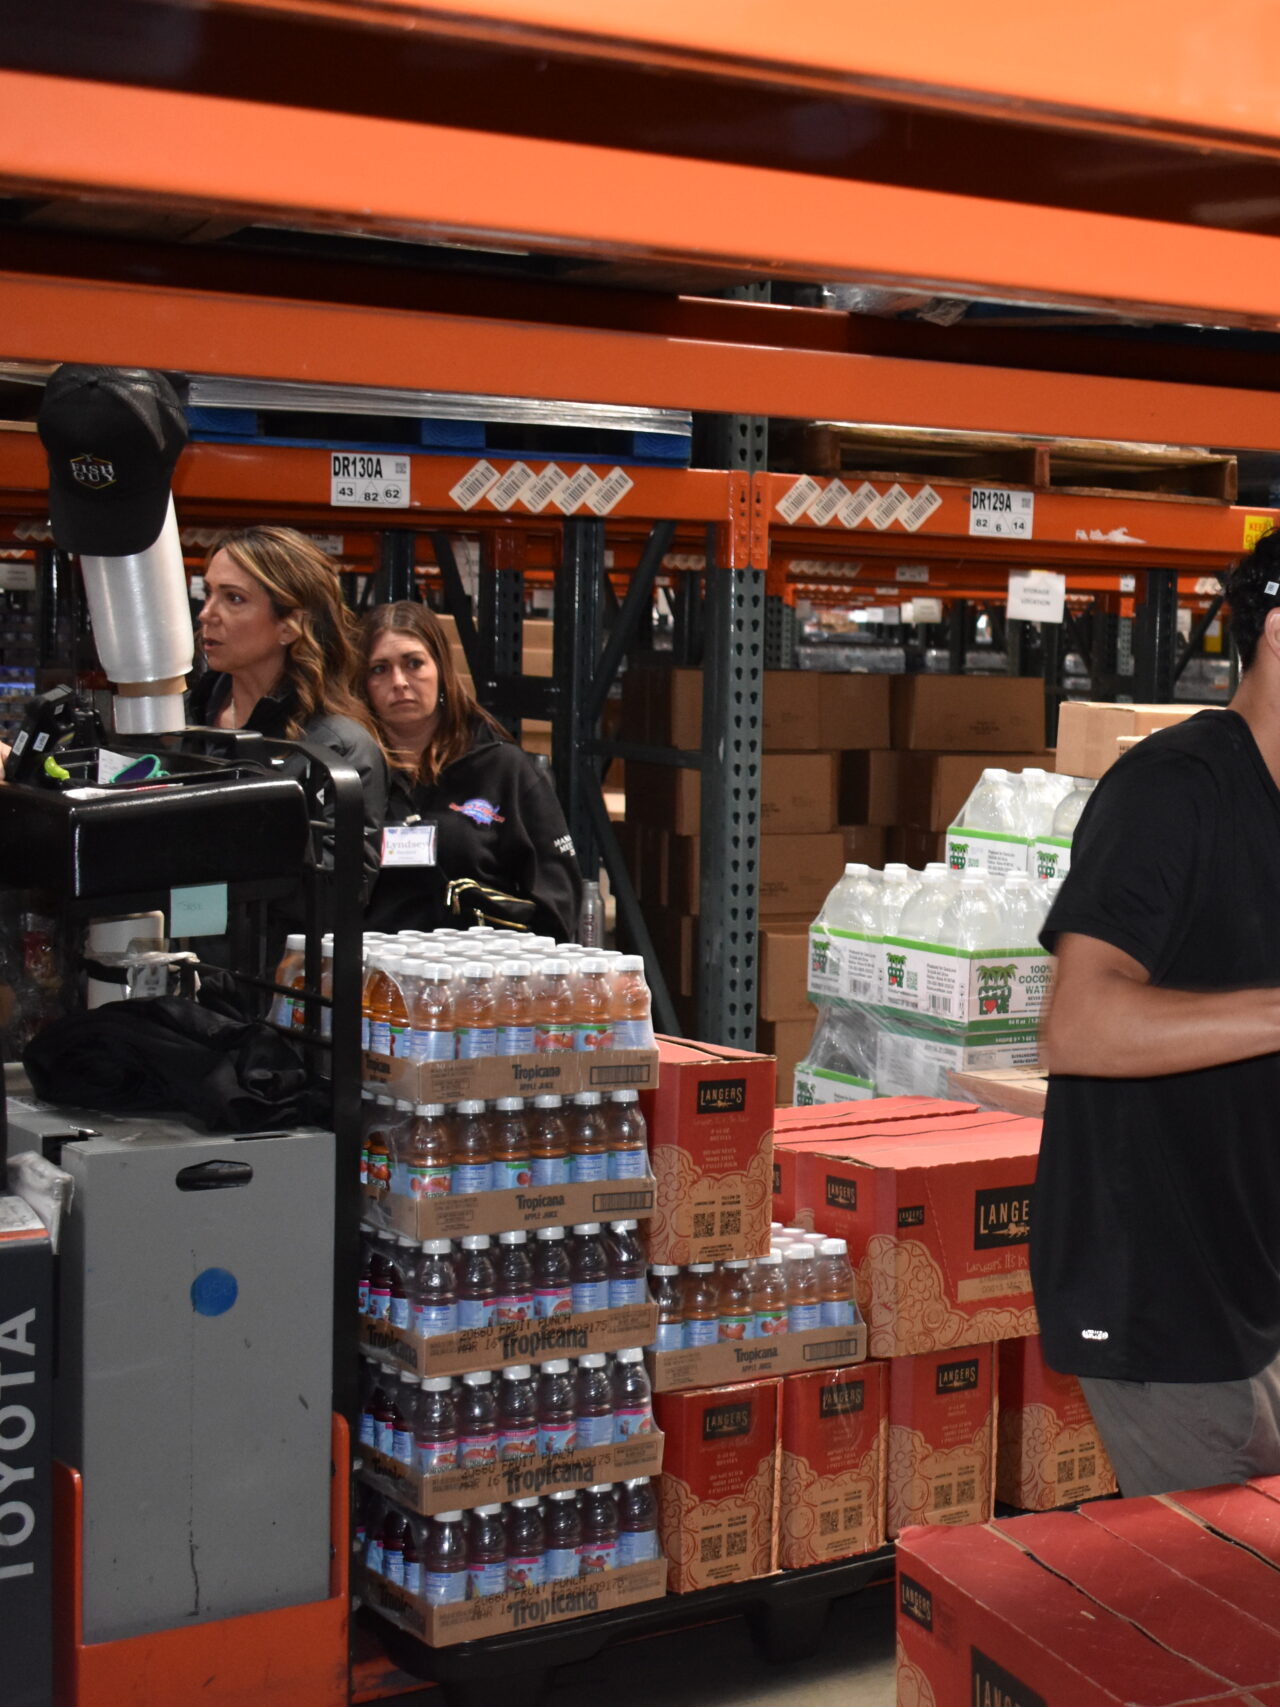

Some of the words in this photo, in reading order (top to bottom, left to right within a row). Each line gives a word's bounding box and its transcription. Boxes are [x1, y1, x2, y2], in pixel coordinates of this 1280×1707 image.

[71, 462, 113, 474] FISH
[73, 471, 114, 482] GUY
[332, 456, 383, 479] DR130A
[339, 487, 354, 497] 43
[364, 492, 379, 502] 82
[385, 489, 400, 499] 62
[971, 491, 1012, 513] DR129A
[975, 519, 988, 528] 82
[1013, 521, 1025, 530] 14
[1019, 975, 1053, 984] COCON
[512, 1064, 560, 1081] Tropicana
[701, 1087, 742, 1106] LANGERS
[516, 1194, 565, 1210] Tropicana
[827, 1182, 855, 1204] LANGERS
[979, 1200, 1030, 1235] LANGE
[499, 1330, 588, 1358] Tropicana
[734, 1347, 778, 1362] Tropicana
[939, 1367, 976, 1388] LANGERS
[706, 1410, 748, 1432] LANGERS
[0, 1307, 36, 1580] TOYOTA
[502, 1464, 593, 1496] Tropicana
[510, 1592, 598, 1628] Tropicana
